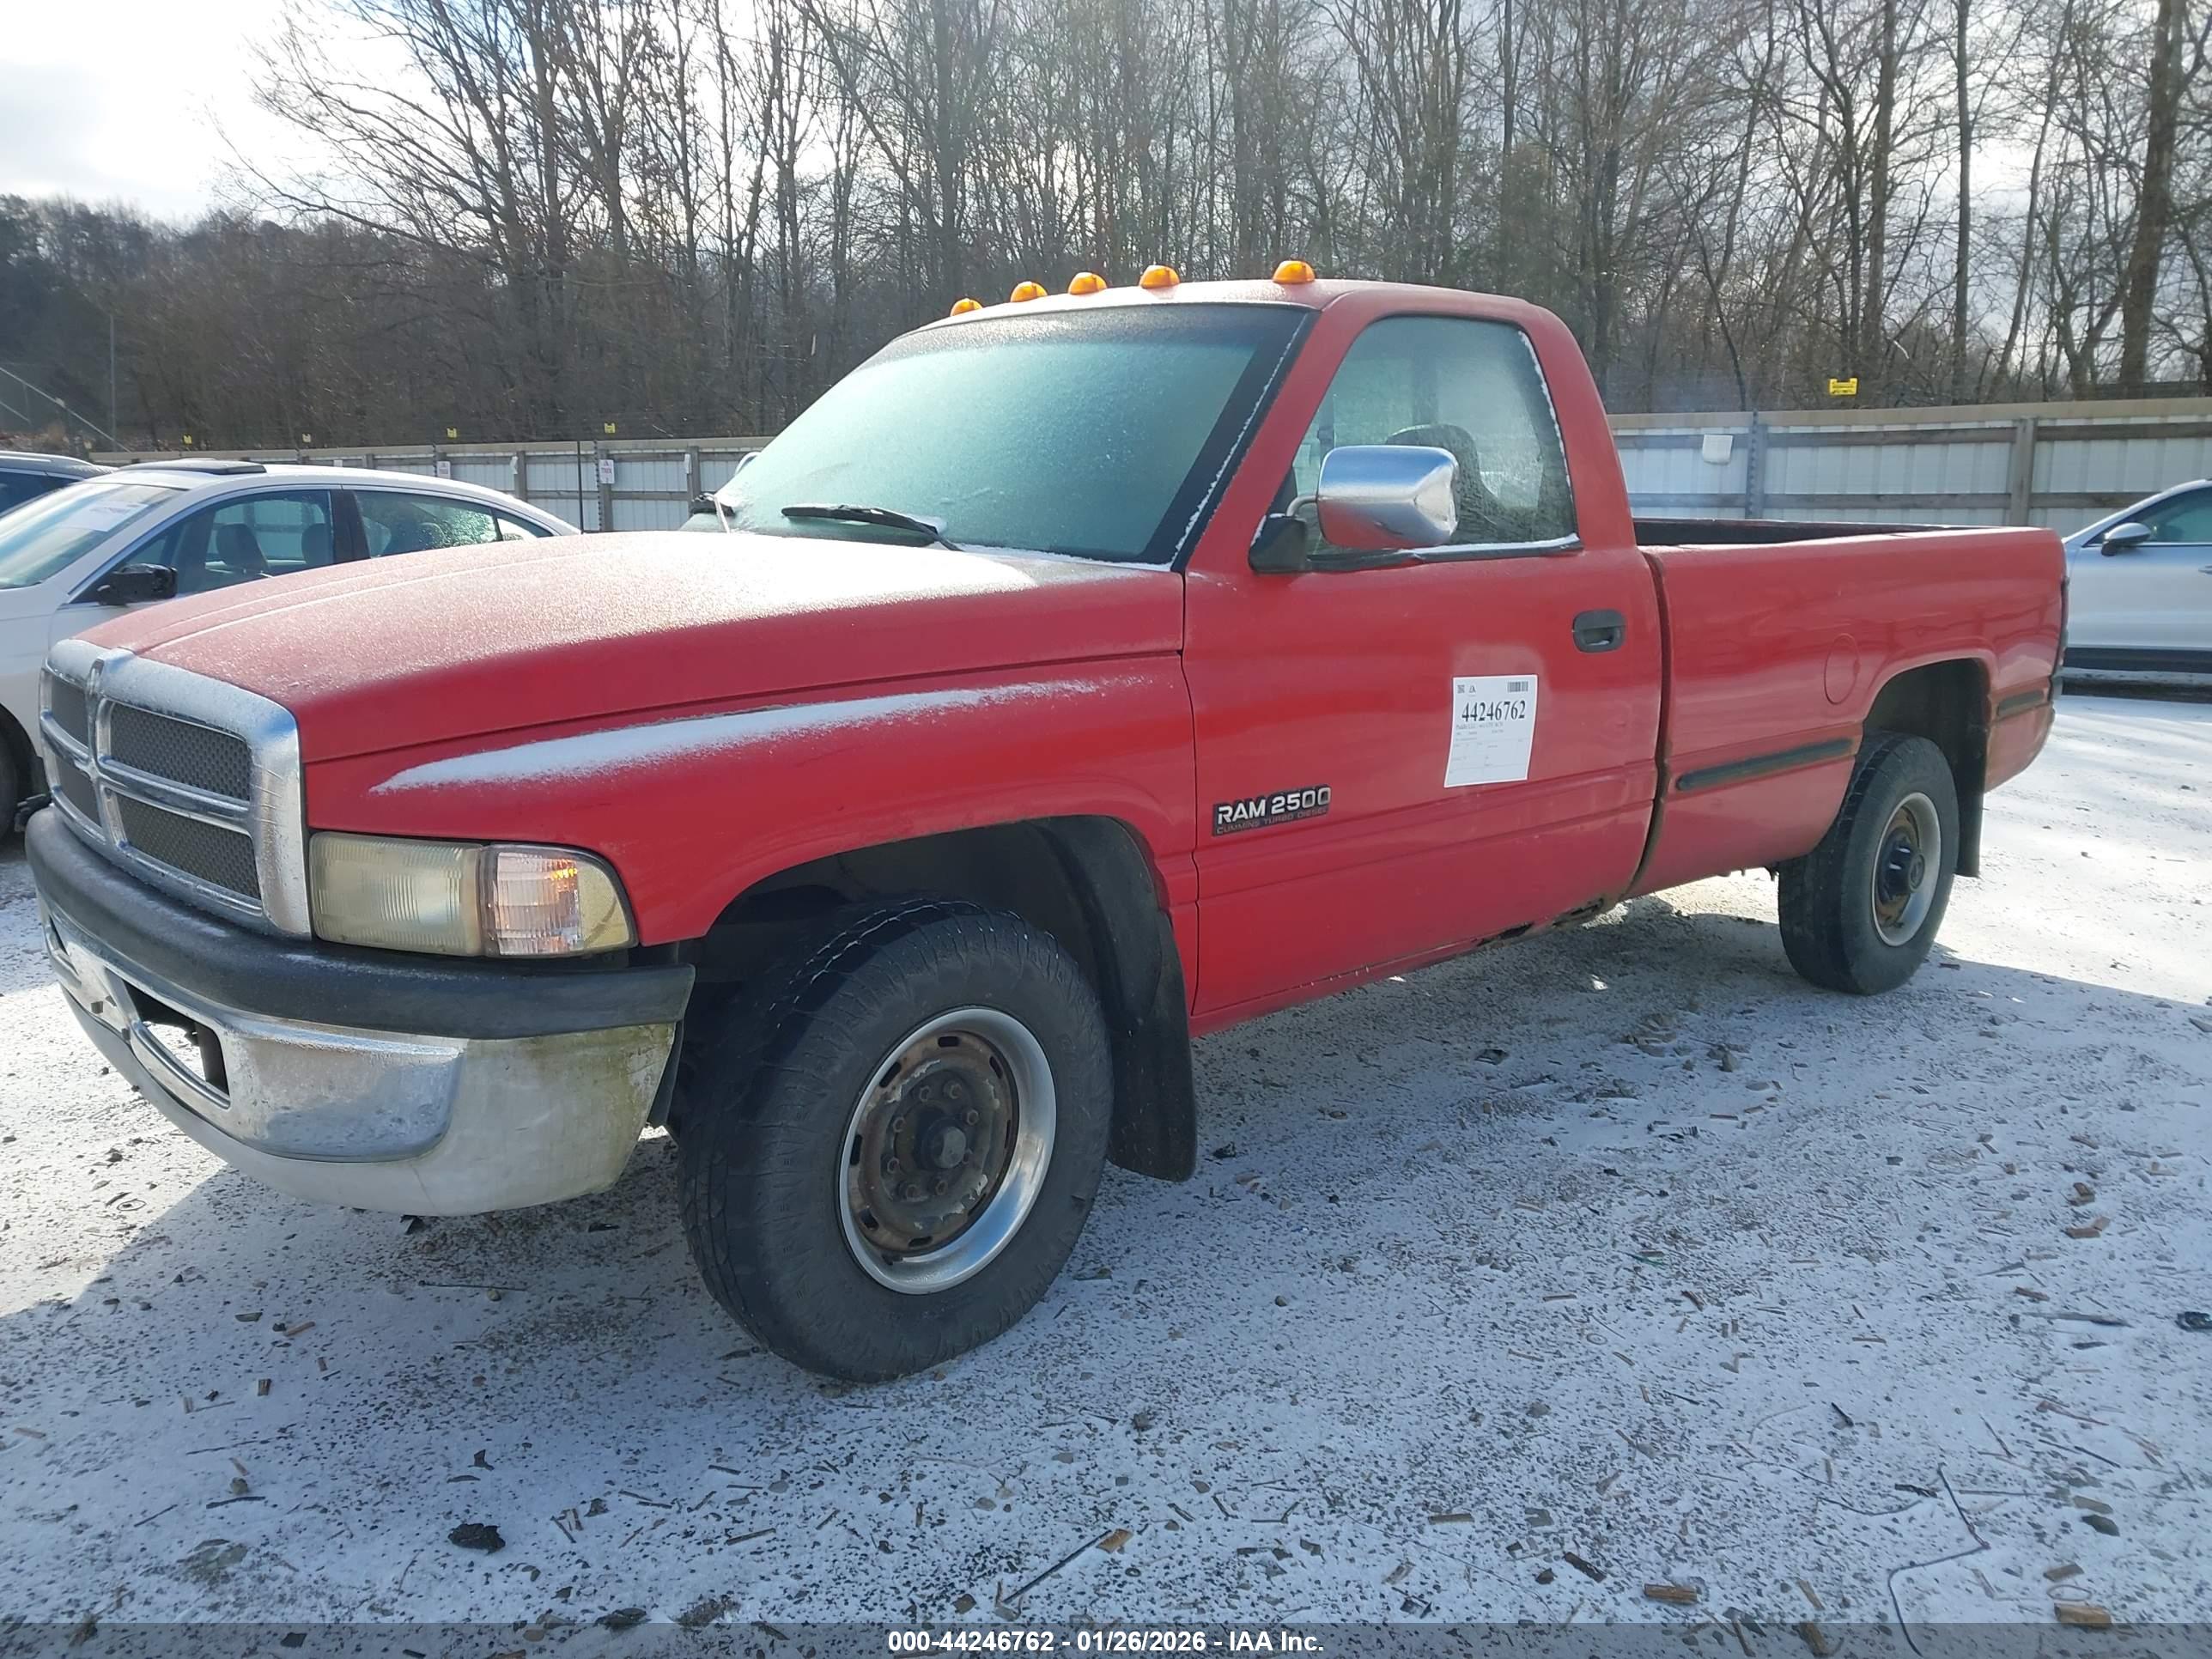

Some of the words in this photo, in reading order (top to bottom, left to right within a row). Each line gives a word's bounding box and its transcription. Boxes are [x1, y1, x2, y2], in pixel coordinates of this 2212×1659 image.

[1462, 700, 1526, 722] 44246762
[1218, 799, 1267, 825] RAM
[1271, 787, 1332, 815] 2500
[1216, 820, 1261, 835] CUMMINS
[1264, 814, 1294, 825] TURBO
